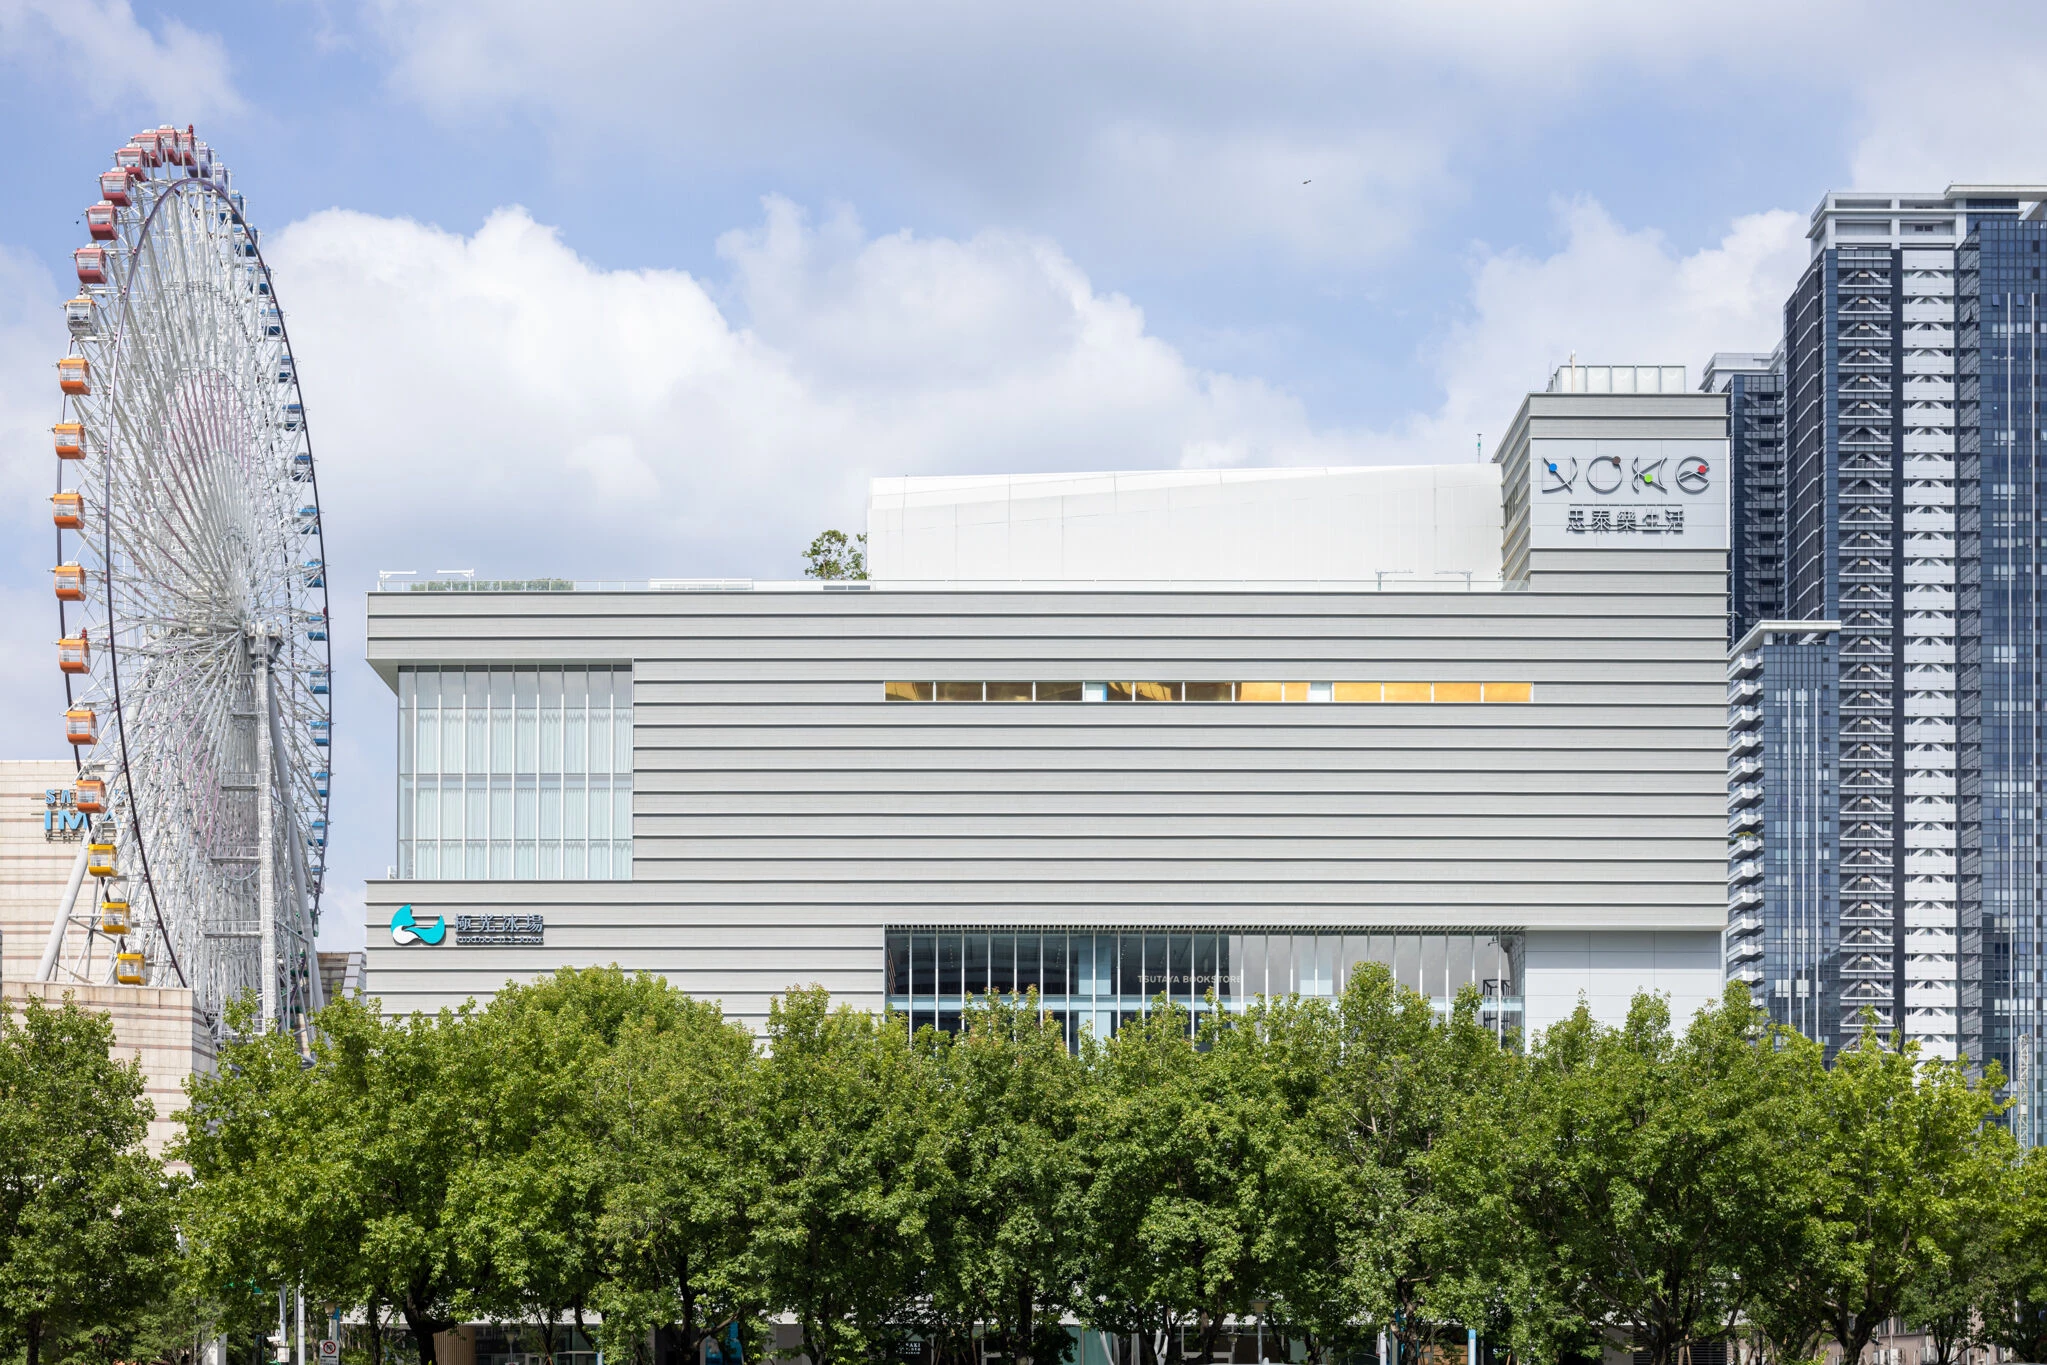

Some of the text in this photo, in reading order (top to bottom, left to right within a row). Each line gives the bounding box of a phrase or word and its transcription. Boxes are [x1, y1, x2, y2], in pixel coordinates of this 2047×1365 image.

[1567, 507, 1684, 533] 忠泰樂生活
[455, 913, 543, 933] 極光冰場
[1137, 975, 1242, 984] TSUTAYA BOOKSTORE
